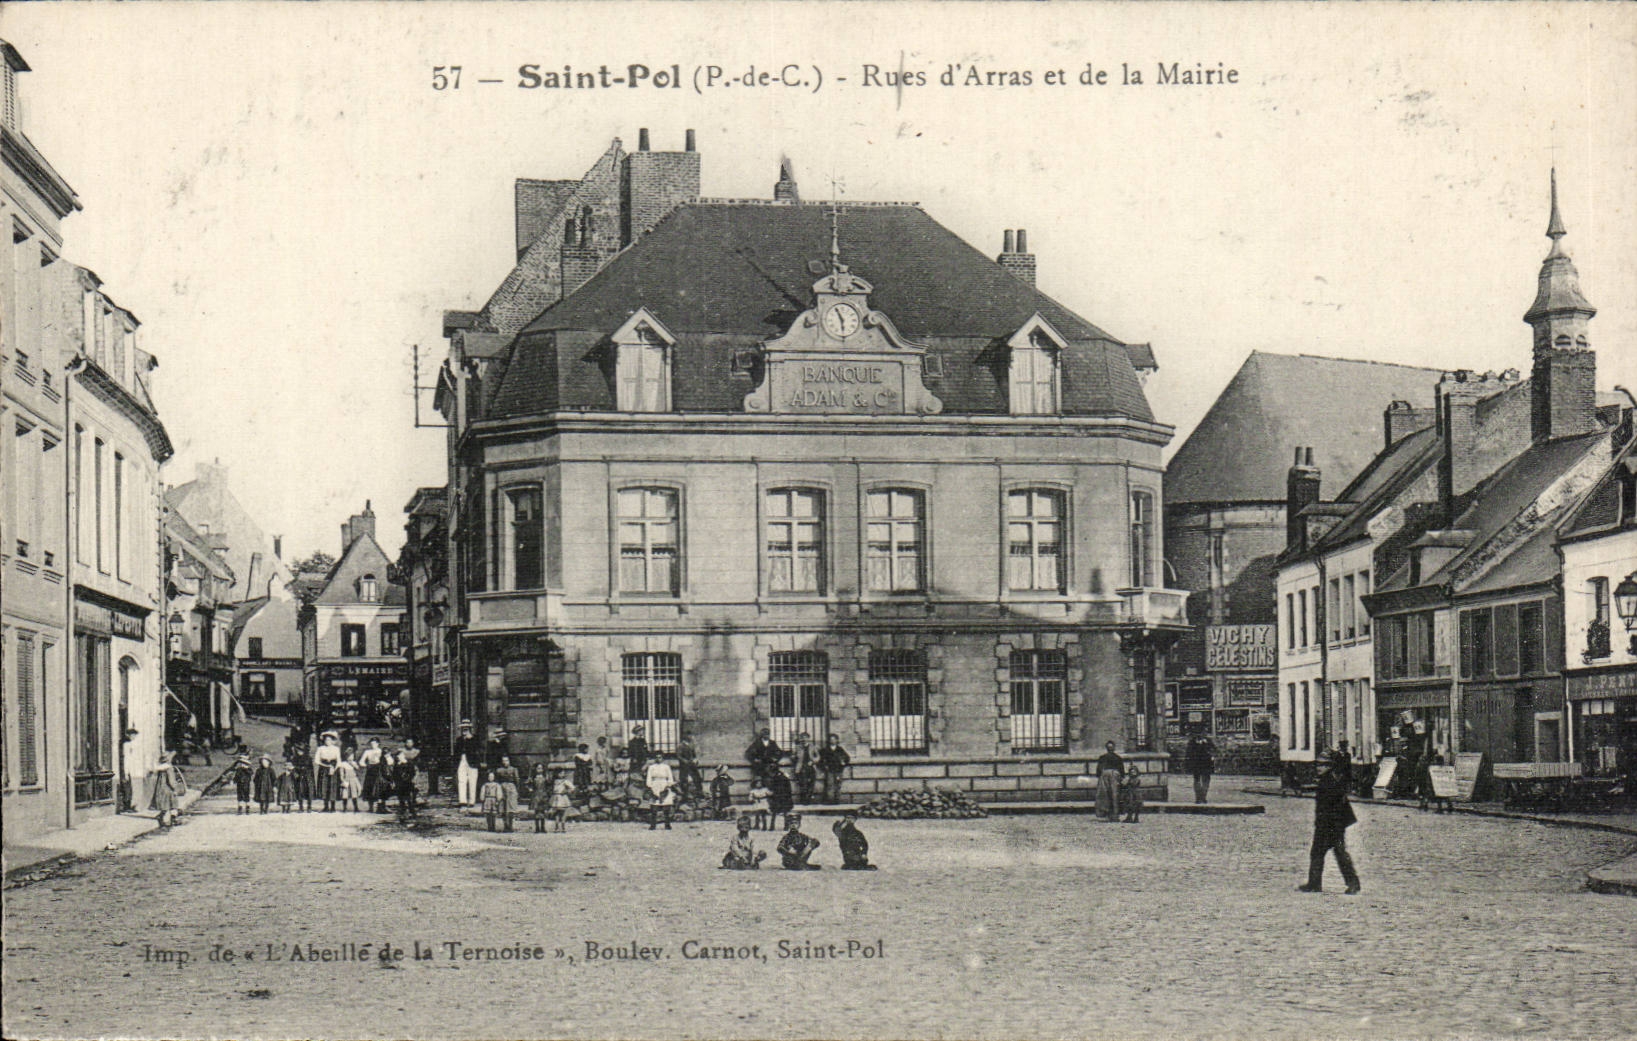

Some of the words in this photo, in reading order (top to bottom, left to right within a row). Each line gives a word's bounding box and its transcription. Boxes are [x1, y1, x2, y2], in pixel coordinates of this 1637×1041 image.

[802, 366, 882, 384] BANQUE
[791, 389, 848, 408] ADAM
[852, 390, 869, 408] &
[1208, 626, 1269, 646] VICHY
